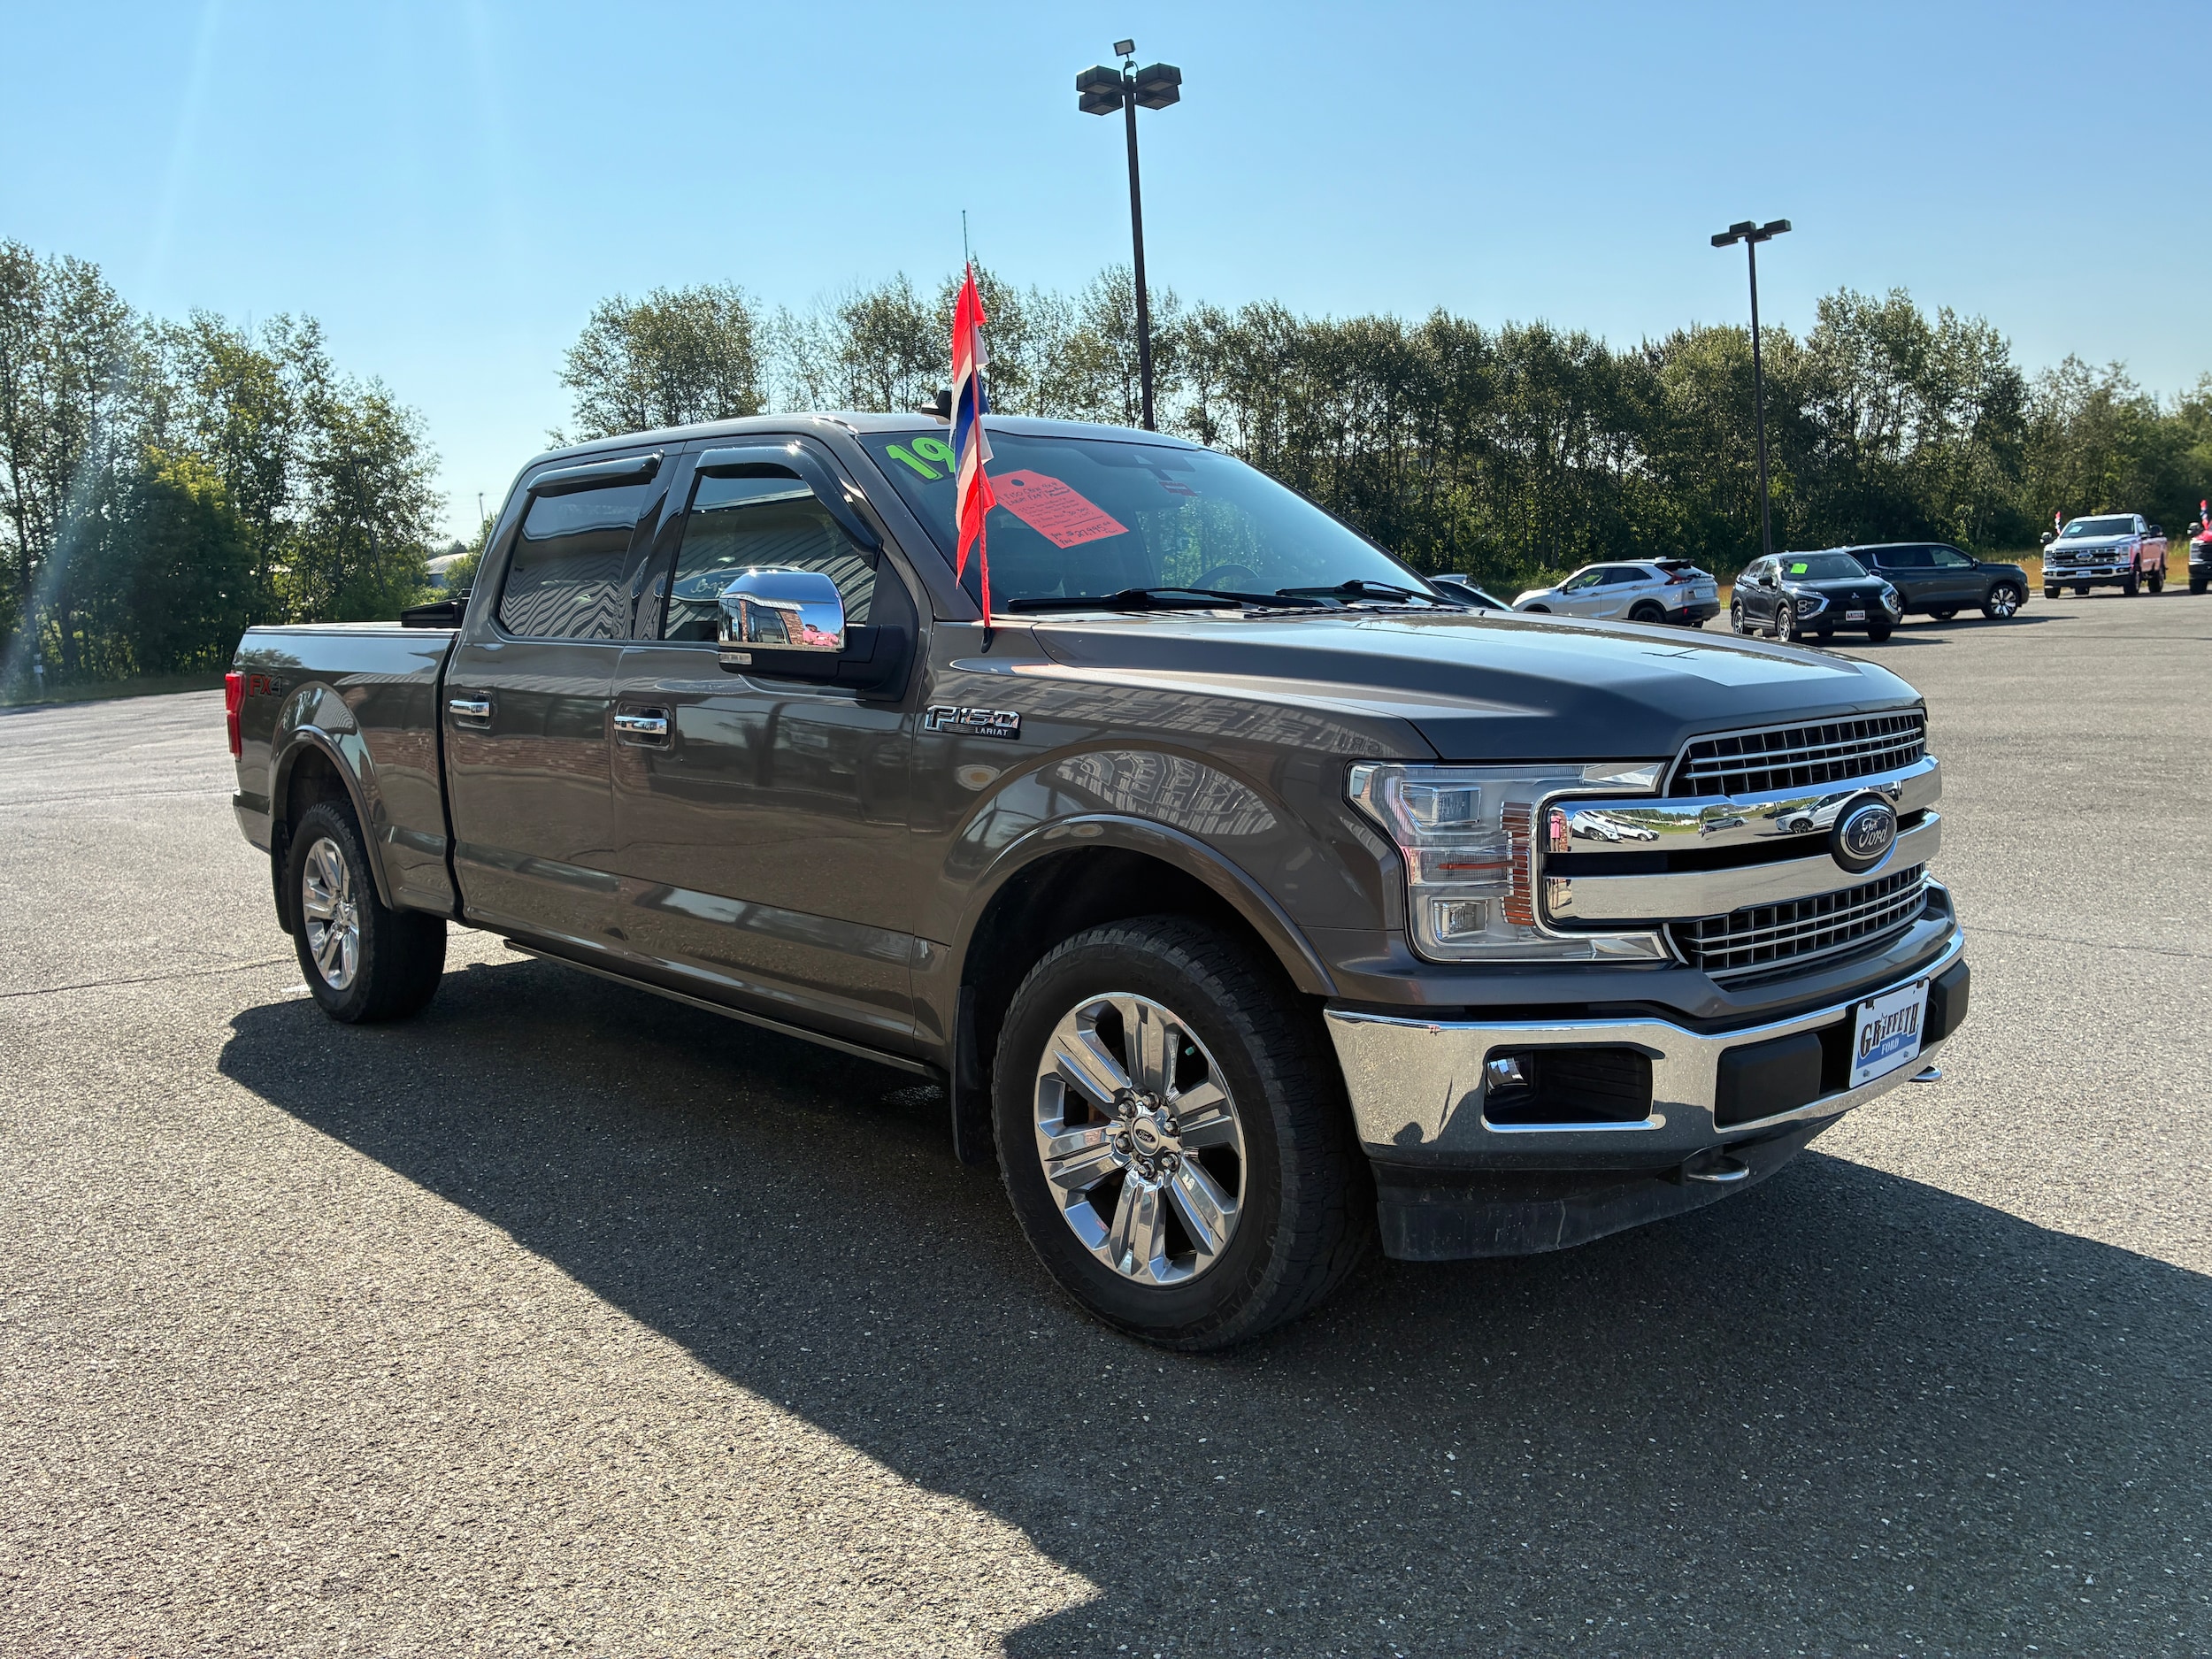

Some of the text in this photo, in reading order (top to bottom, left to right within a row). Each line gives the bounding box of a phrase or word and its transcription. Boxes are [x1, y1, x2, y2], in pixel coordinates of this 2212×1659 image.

[886, 437, 955, 480] 19
[249, 674, 282, 697] FX4
[975, 726, 1009, 736] LARIAT
[1858, 817, 1888, 849] Ford
[1880, 1037, 1900, 1055] FORD
[1138, 1130, 1153, 1142] Ford
